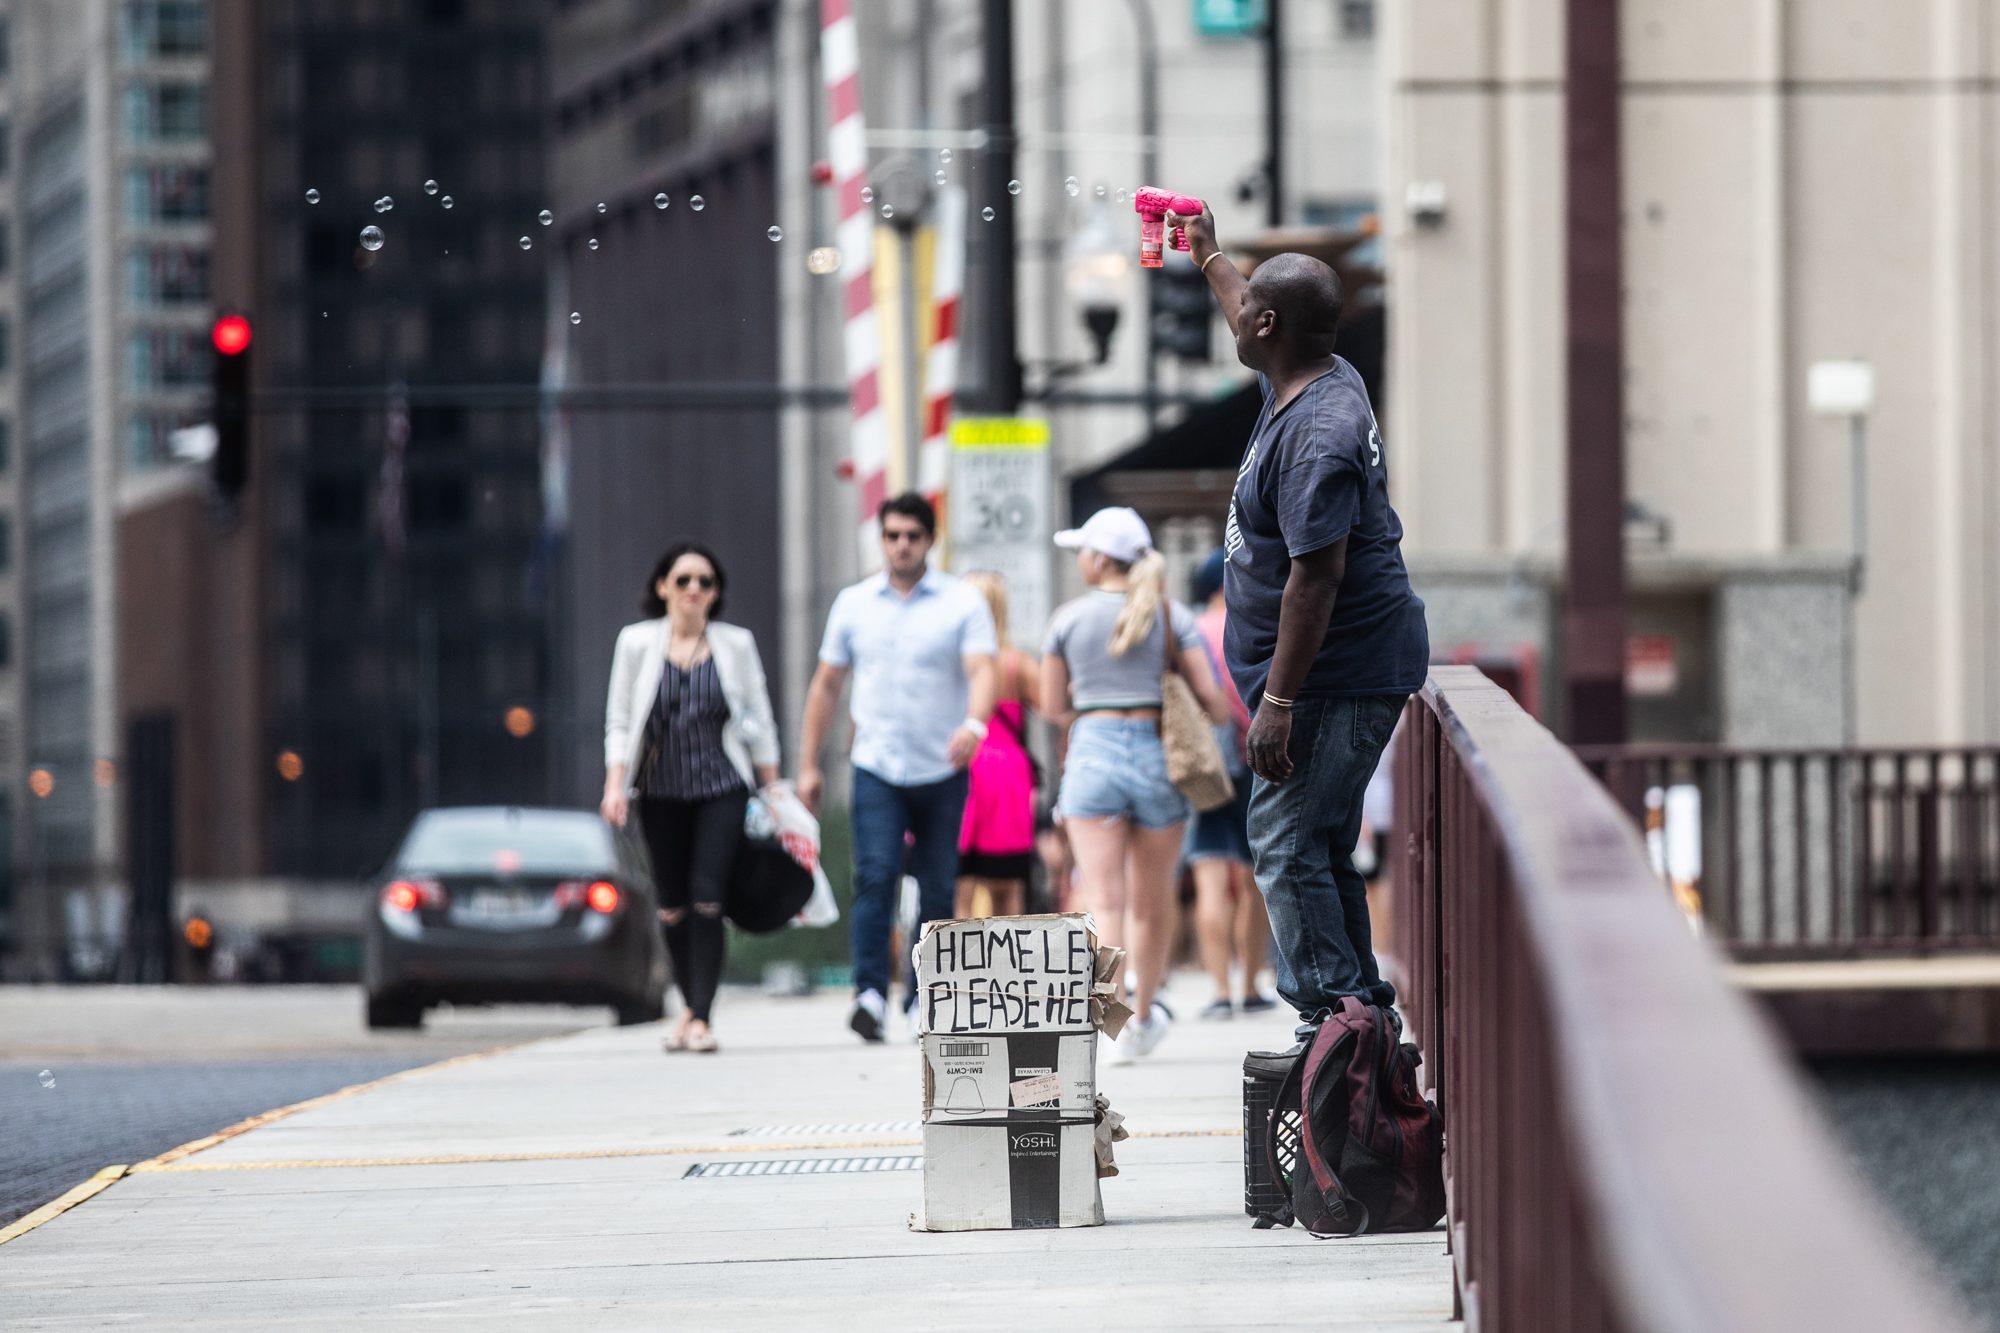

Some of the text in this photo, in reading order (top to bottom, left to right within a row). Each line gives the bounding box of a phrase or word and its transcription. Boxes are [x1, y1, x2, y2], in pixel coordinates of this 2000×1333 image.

[936, 928, 1092, 974] HOMELE
[928, 978, 1039, 1032] PLEASE
[946, 1067, 983, 1075] EMI-CWT9
[1011, 1133, 1055, 1149] YOSHI
